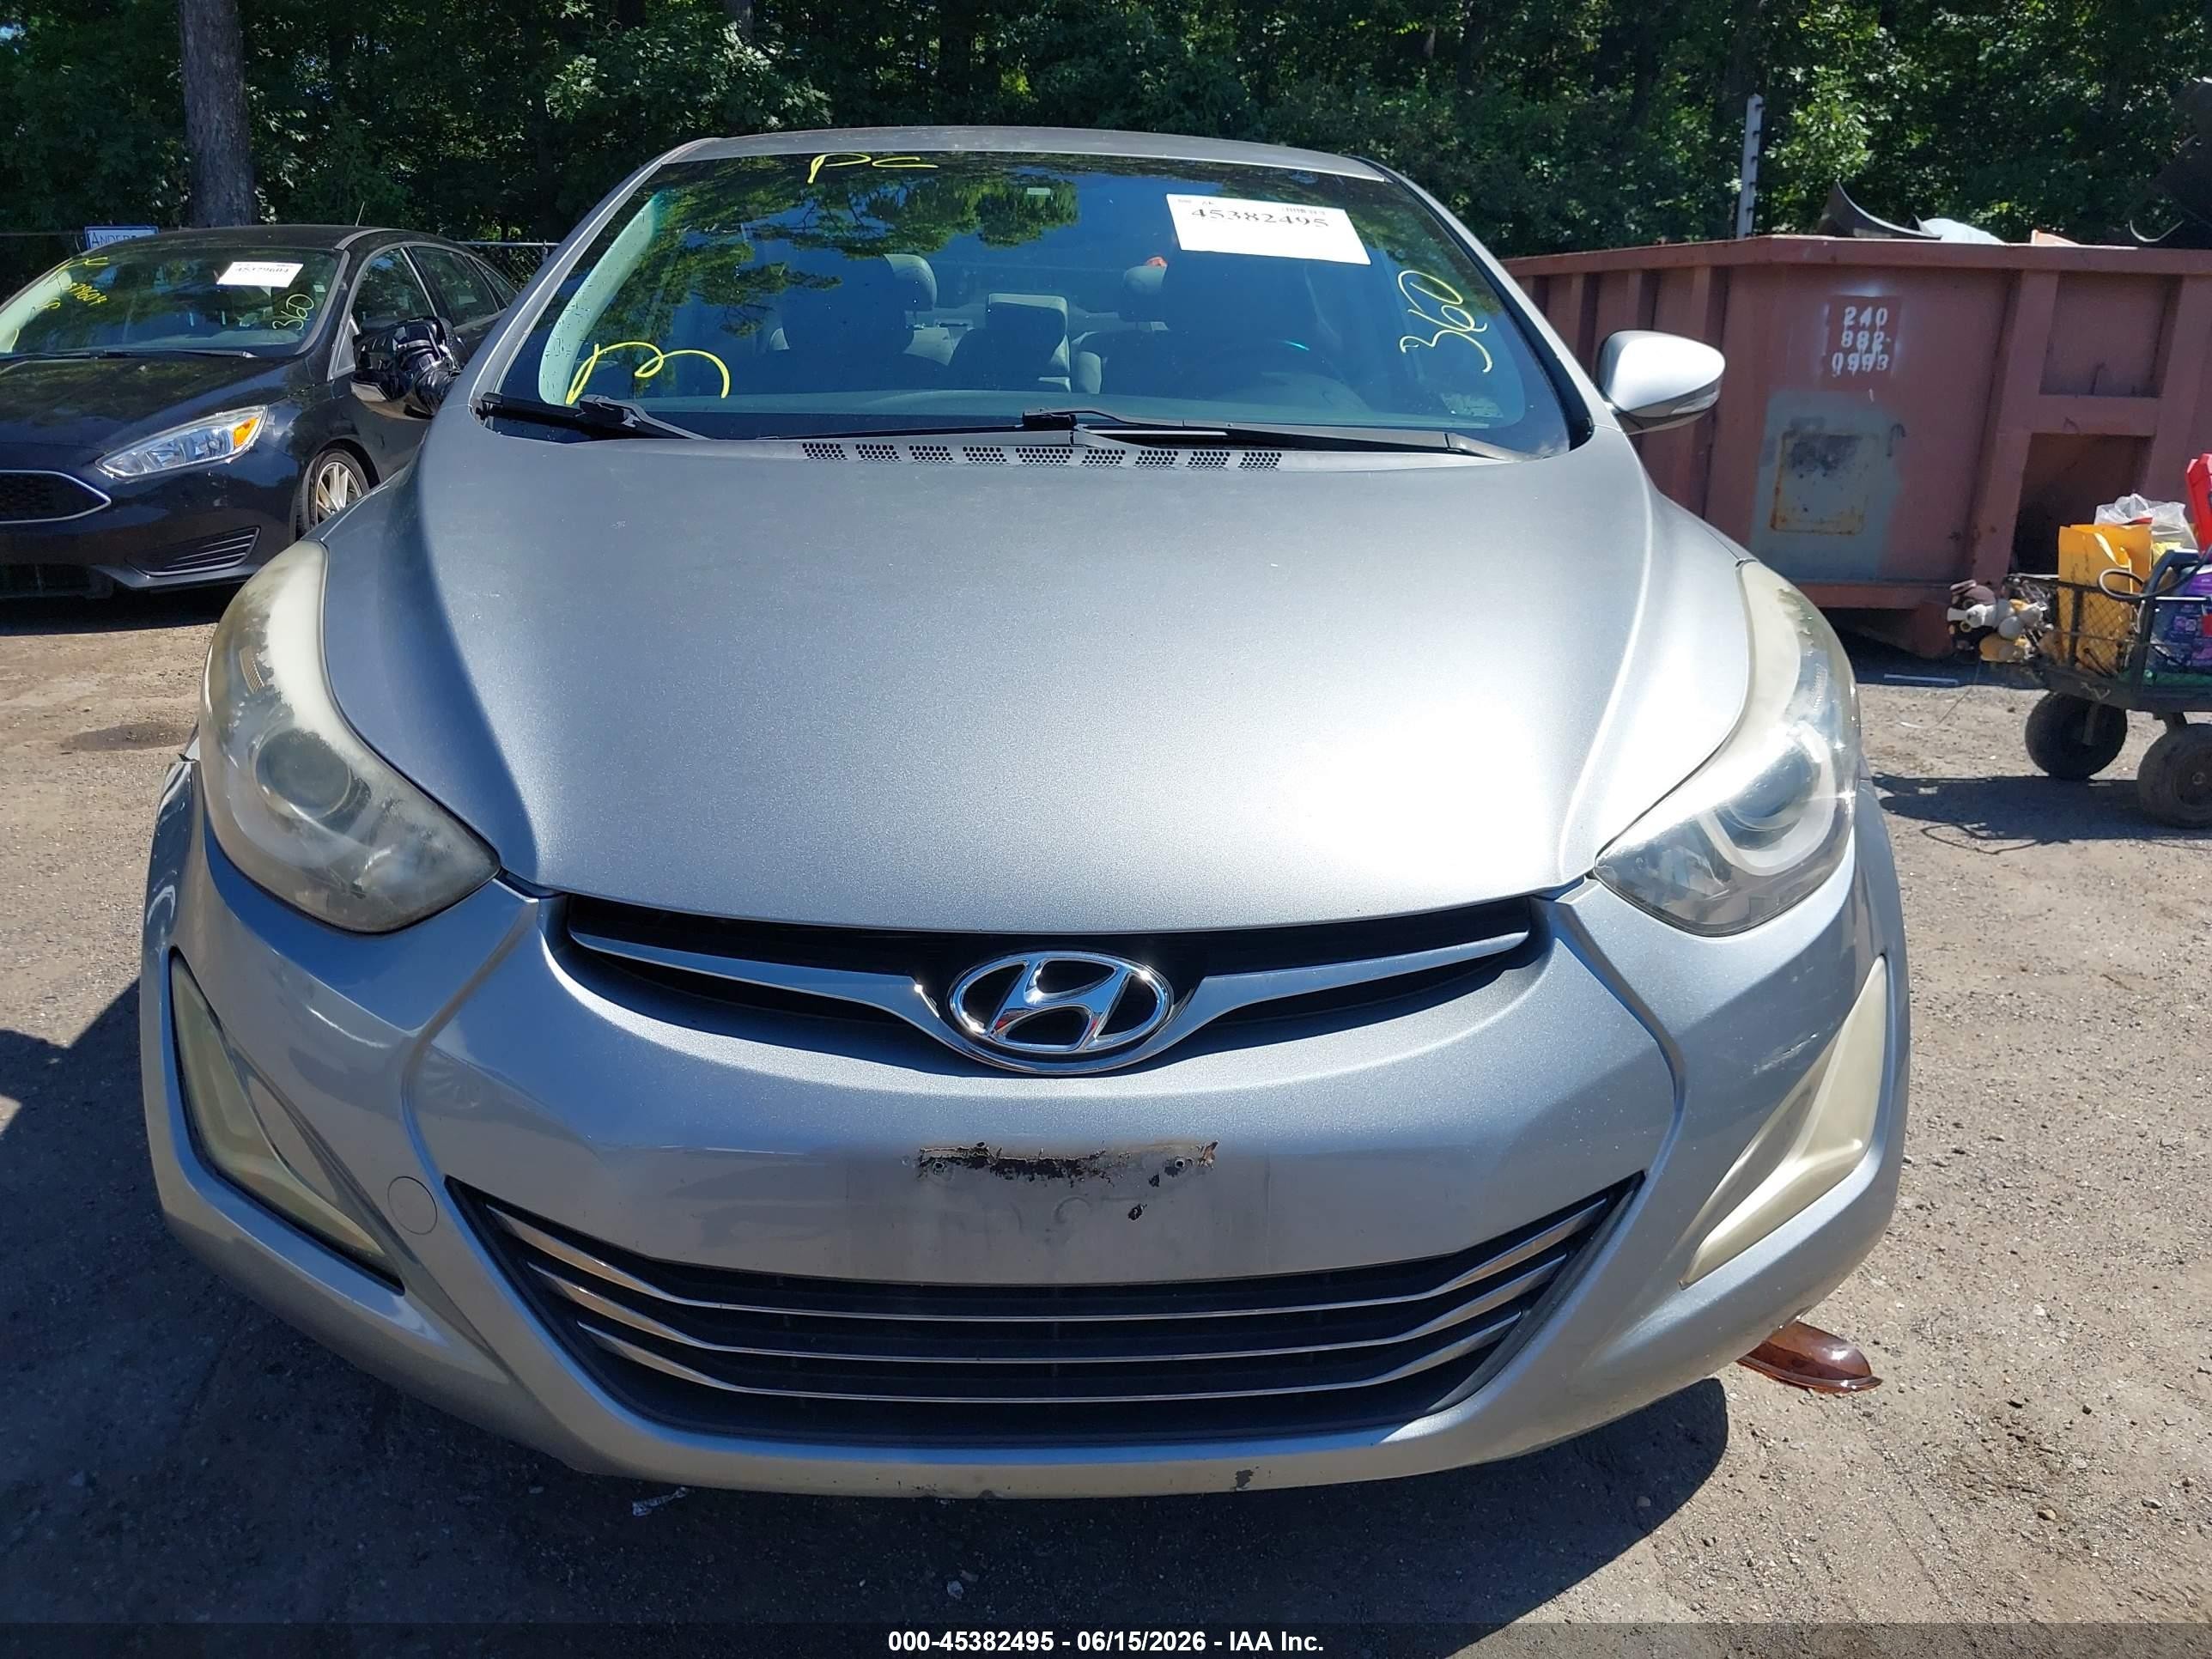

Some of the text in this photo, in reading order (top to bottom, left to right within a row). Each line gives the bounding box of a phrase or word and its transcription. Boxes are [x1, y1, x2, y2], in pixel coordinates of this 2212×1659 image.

[1191, 209, 1329, 228] 45382495
[272, 294, 314, 331] 360
[1397, 270, 1492, 373] 360
[1844, 306, 1888, 328] 240
